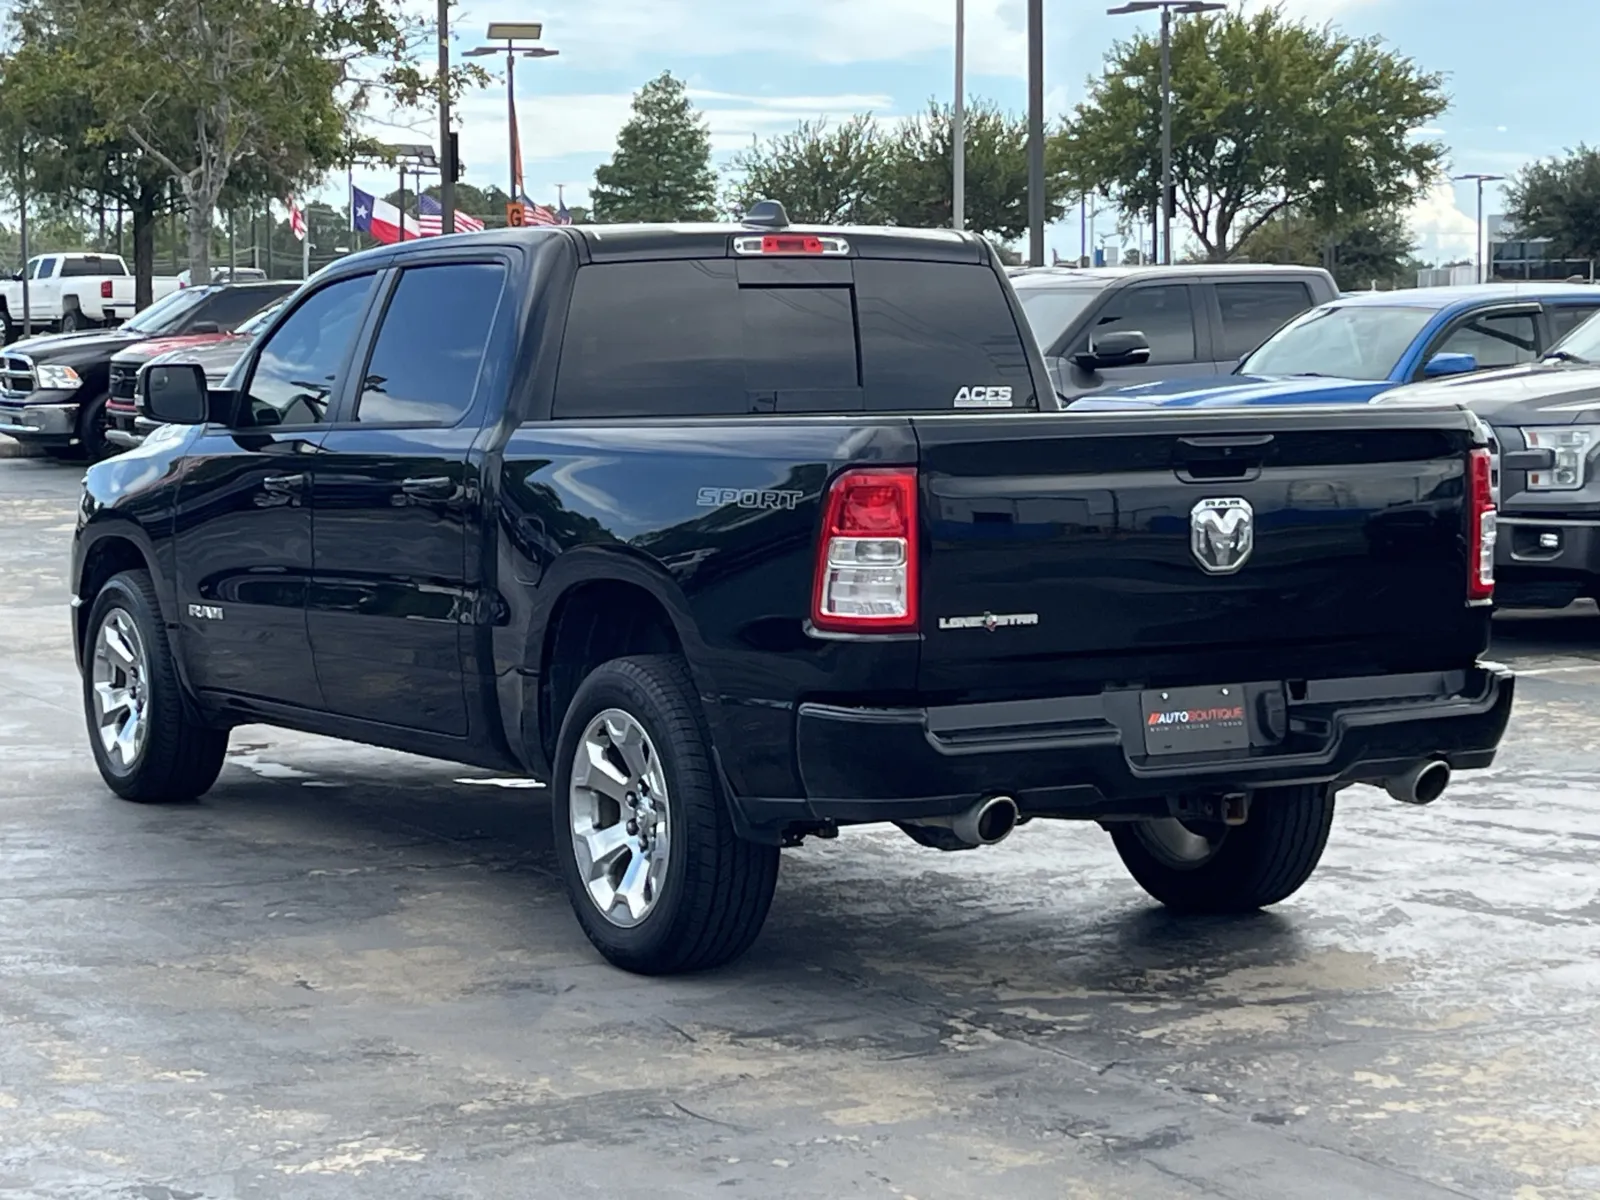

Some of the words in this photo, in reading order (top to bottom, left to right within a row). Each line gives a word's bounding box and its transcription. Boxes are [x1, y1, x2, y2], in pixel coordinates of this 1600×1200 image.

[954, 386, 1013, 401] ACES
[696, 487, 804, 510] SPORT
[188, 604, 224, 620] RAM
[939, 616, 984, 629] LONE
[993, 613, 1039, 626] STAR
